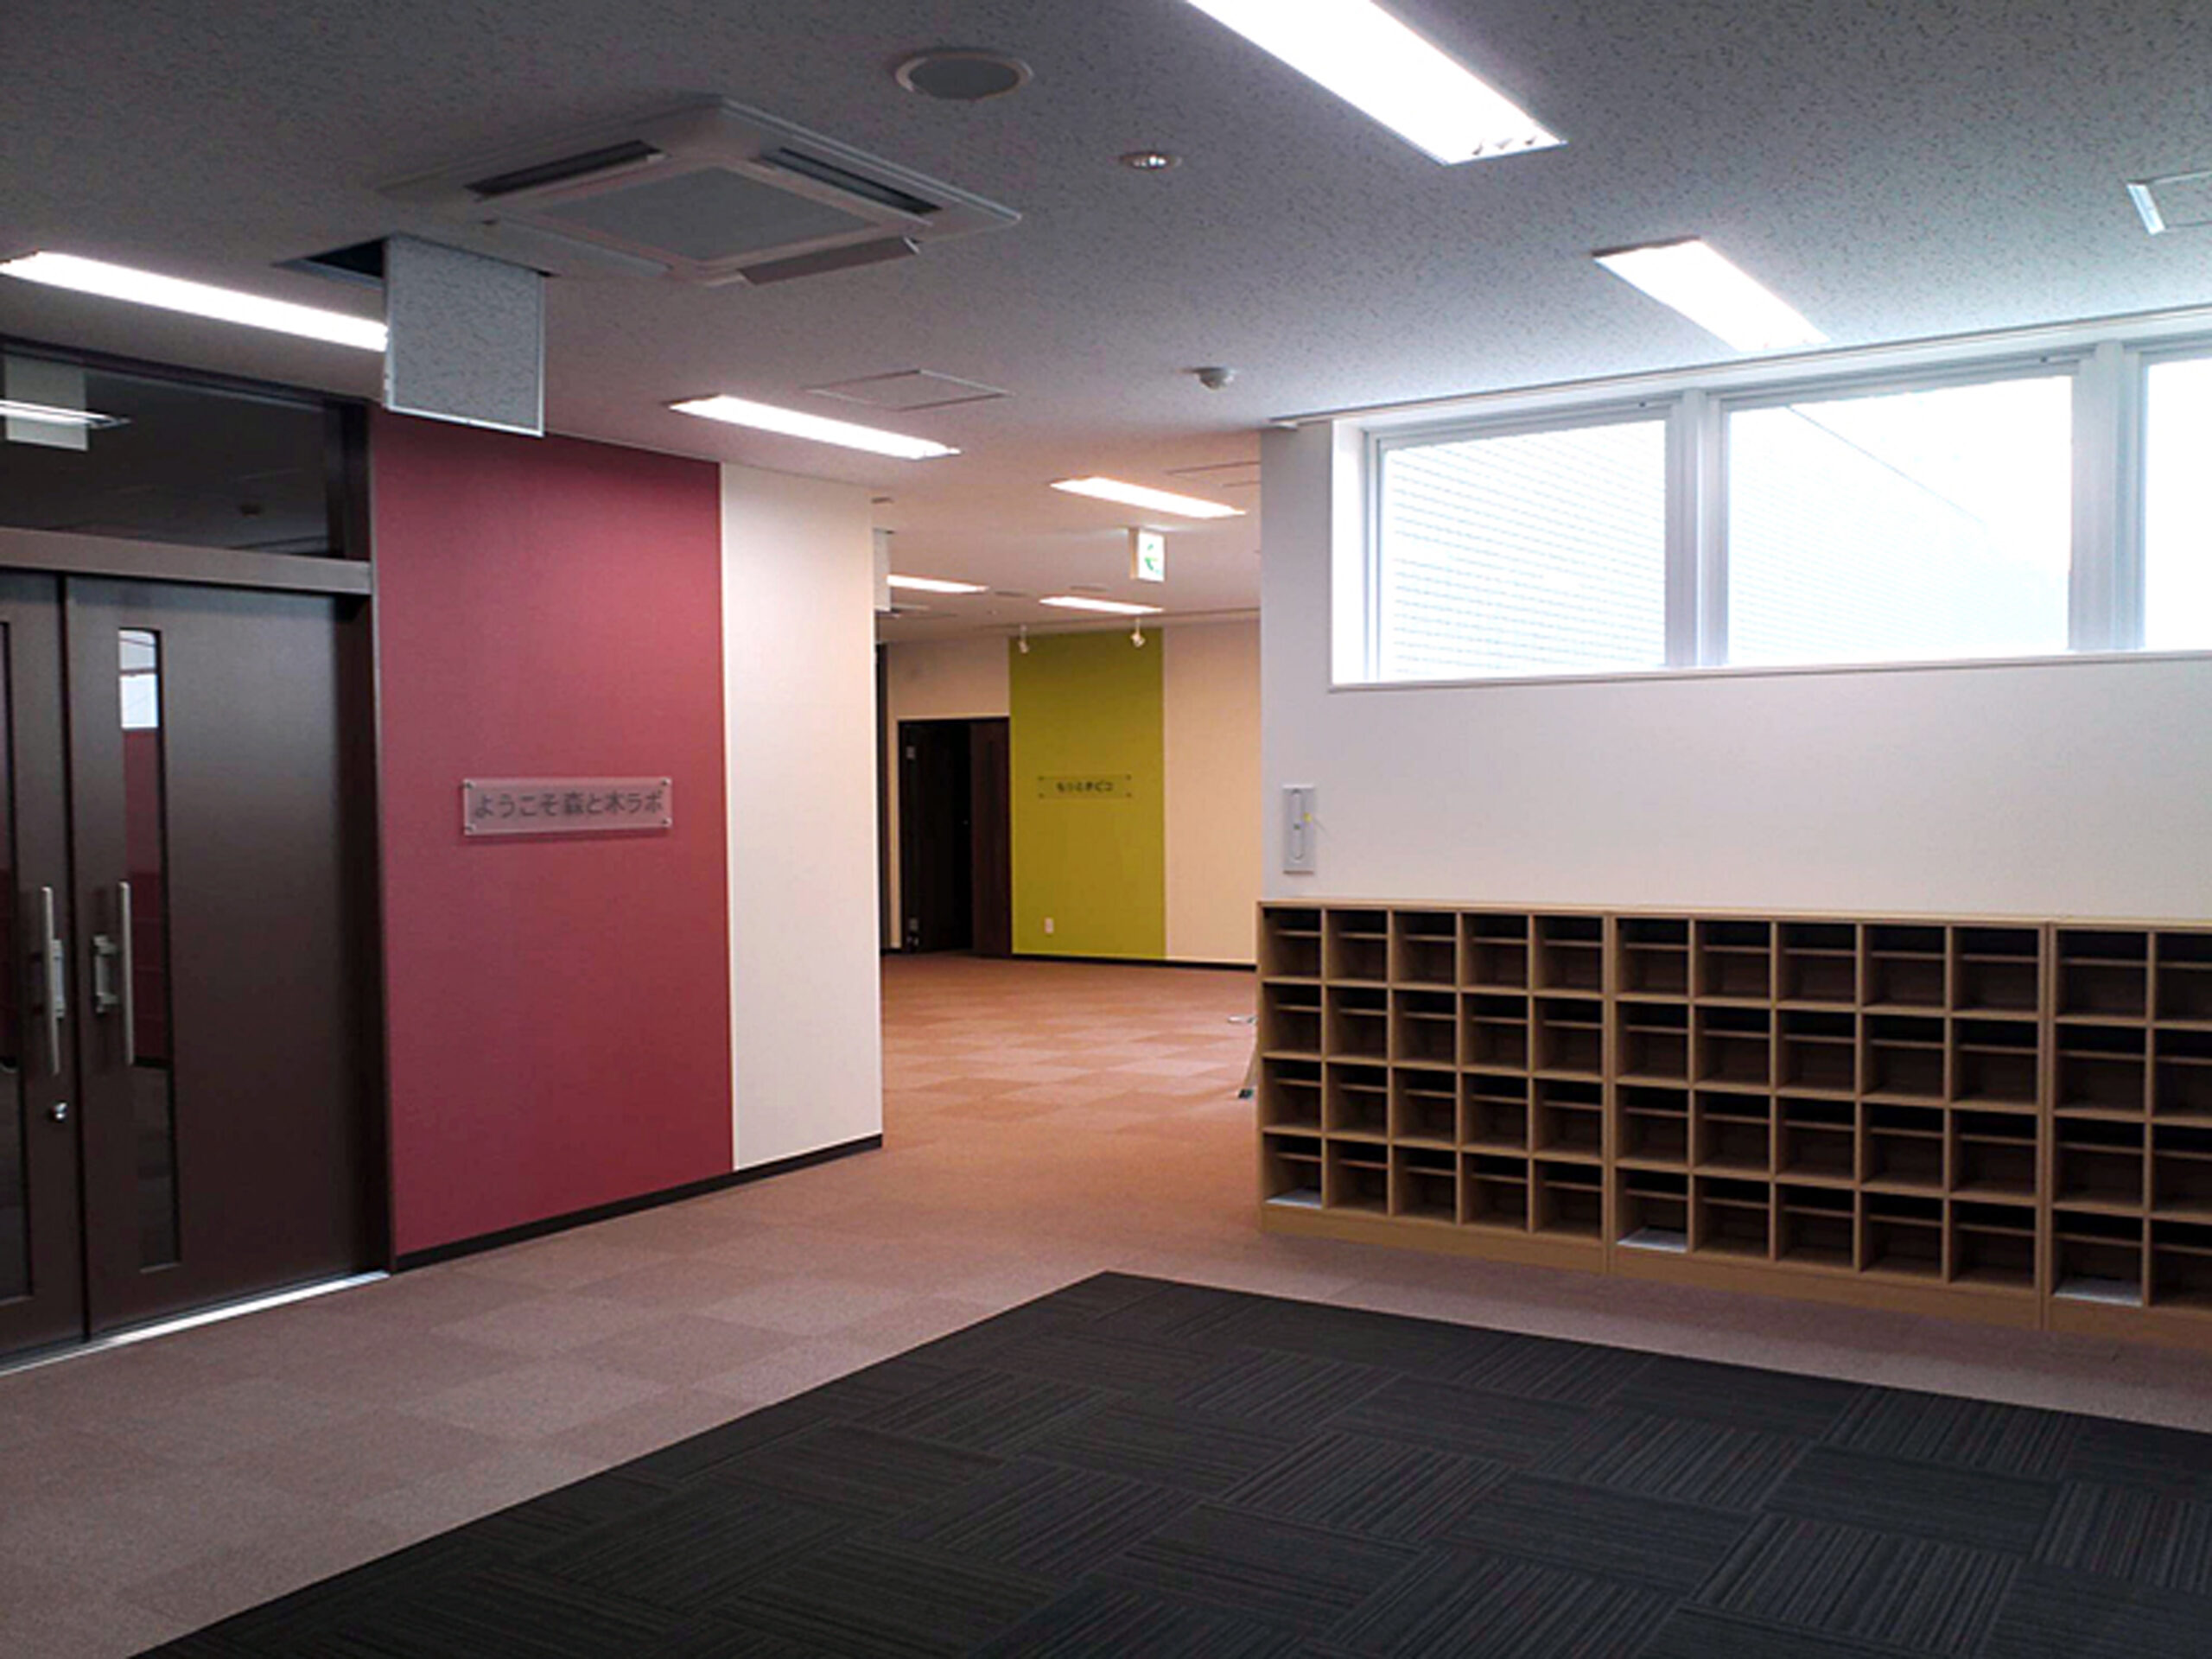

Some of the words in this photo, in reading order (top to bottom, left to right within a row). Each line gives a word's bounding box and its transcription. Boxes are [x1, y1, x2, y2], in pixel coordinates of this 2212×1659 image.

[474, 790, 664, 819] ようこそ森と木ラボ
